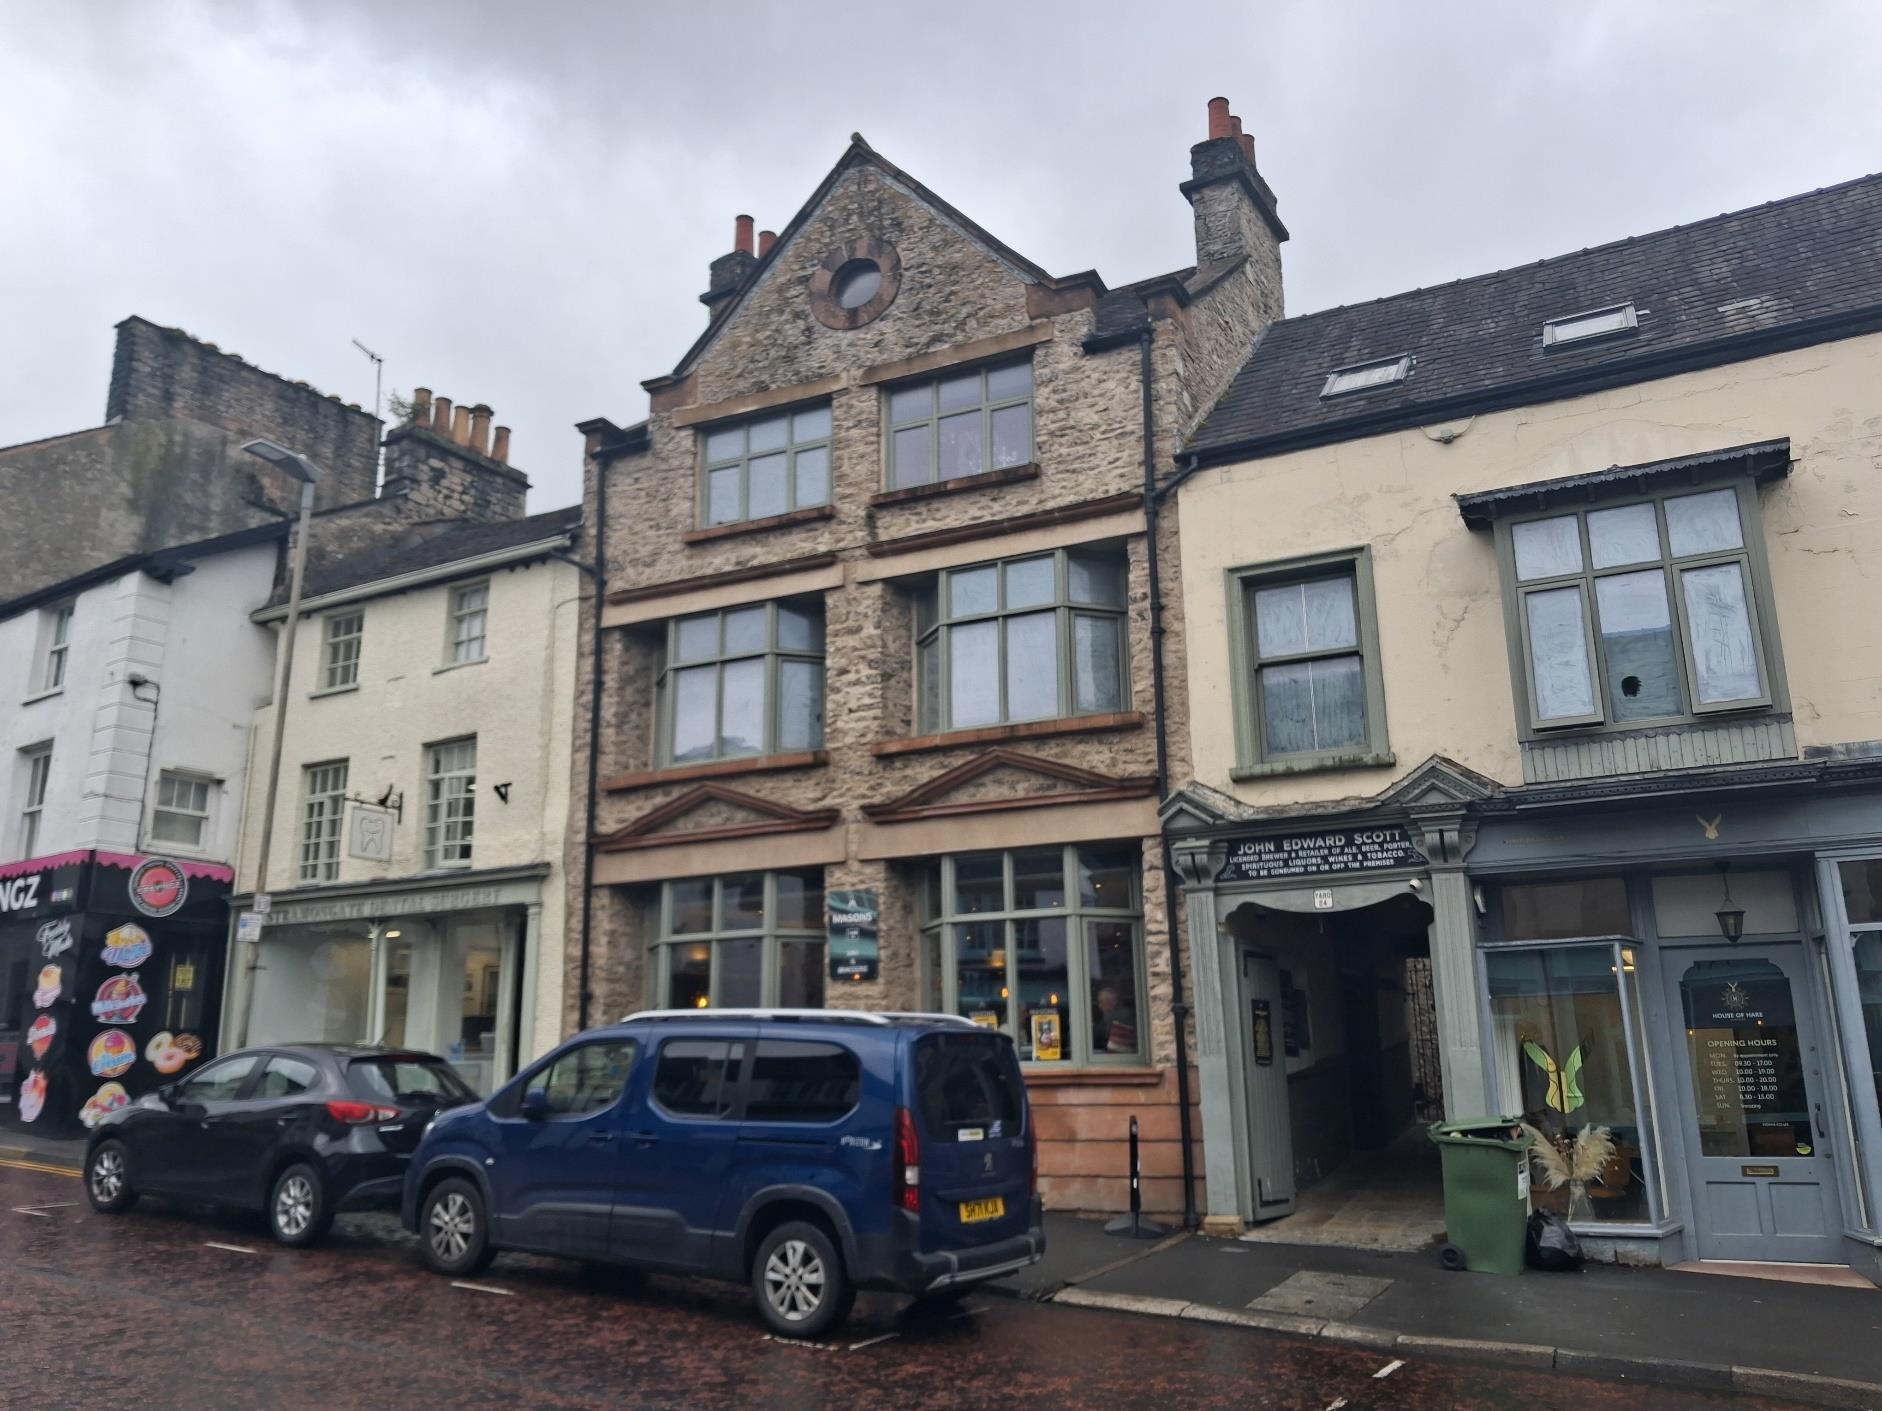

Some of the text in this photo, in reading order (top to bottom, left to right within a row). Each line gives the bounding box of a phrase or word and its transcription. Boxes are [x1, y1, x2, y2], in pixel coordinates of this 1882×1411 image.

[1237, 831, 1401, 855] JOHN EDWARD SCOTT
[1229, 854, 1260, 864] LICENSED
[1261, 852, 1288, 861] BREWER
[1298, 848, 1329, 858] RETAILER
[1241, 860, 1284, 871] SPIRITUOUS
[1327, 854, 1353, 863] WINES
[1248, 869, 1257, 877] TO
[1270, 866, 1305, 876] CONSUMED
[1332, 862, 1345, 870] OFF
[1347, 861, 1360, 869] THE
[1363, 858, 1395, 868] PREMISES
[1707, 1039, 1777, 1048] OPENING HOURS
